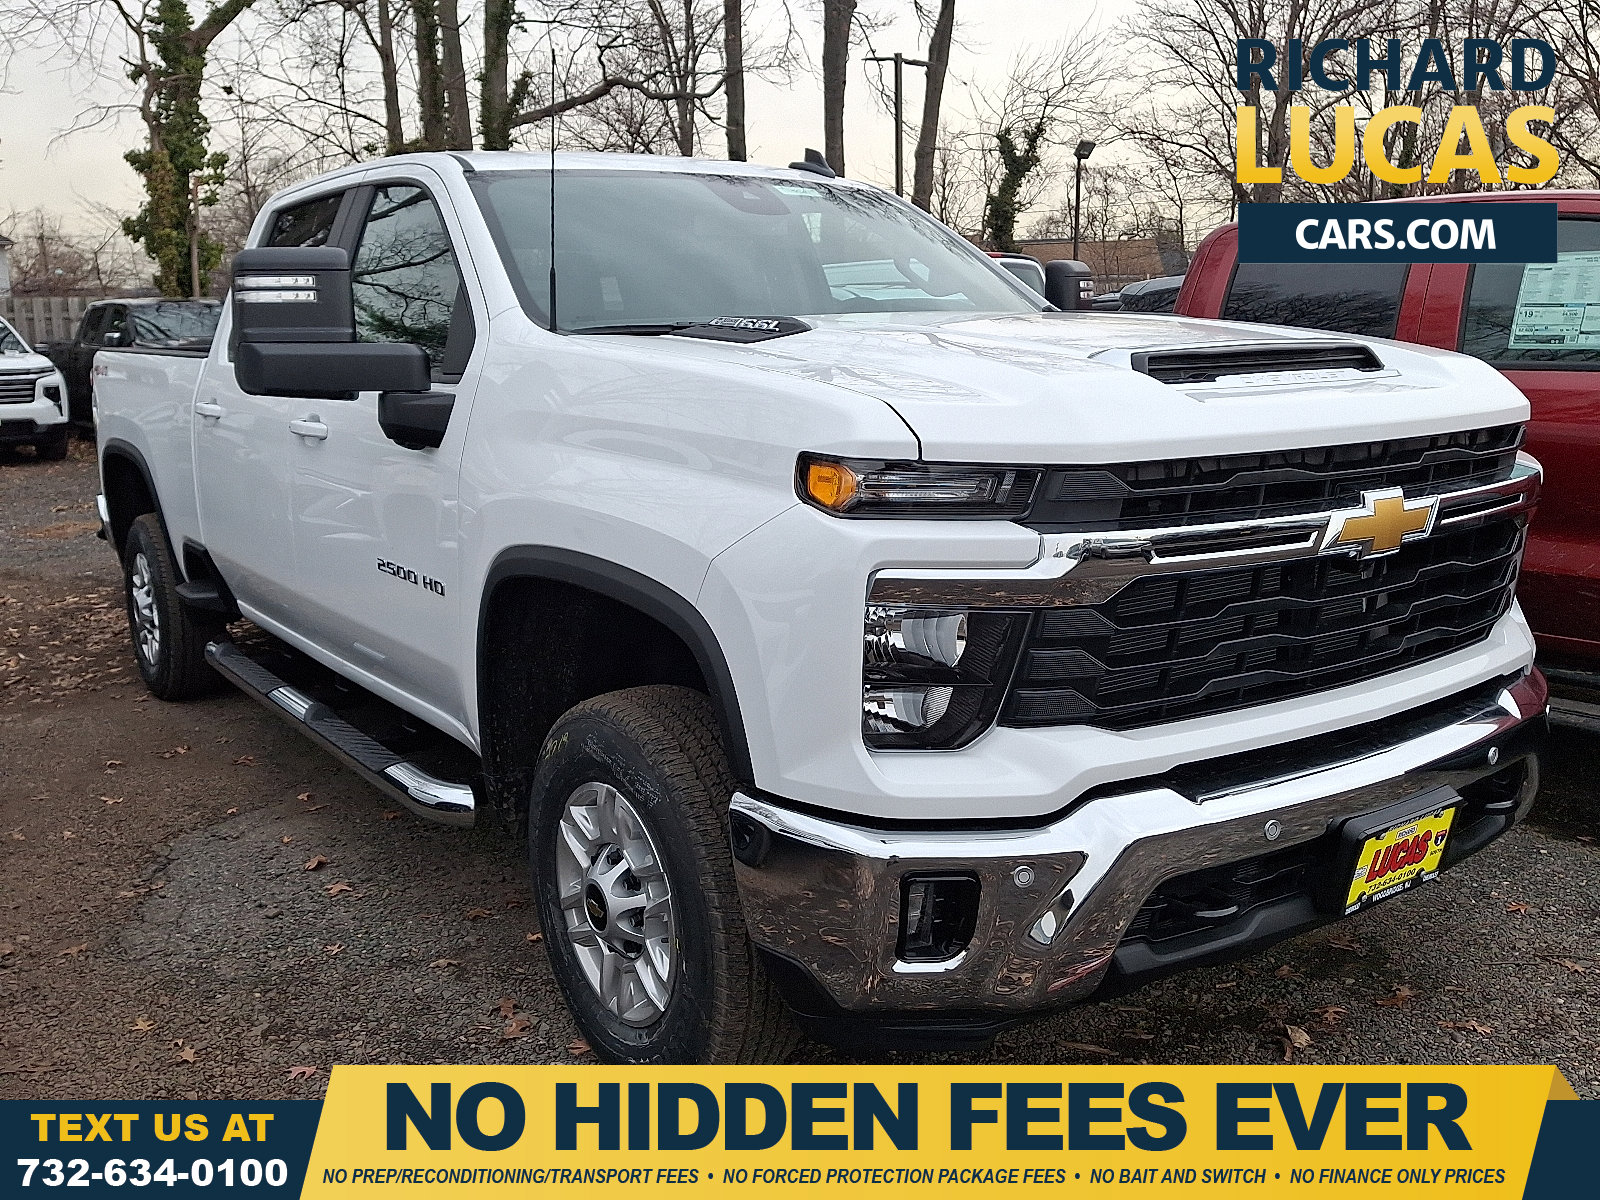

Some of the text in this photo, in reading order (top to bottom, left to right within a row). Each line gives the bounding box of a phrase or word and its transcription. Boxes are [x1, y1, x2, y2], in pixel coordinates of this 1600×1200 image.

[376, 557, 446, 596] 2500 HD
[1365, 830, 1433, 883] LUCAS
[1367, 868, 1417, 893] 732-634-0100
